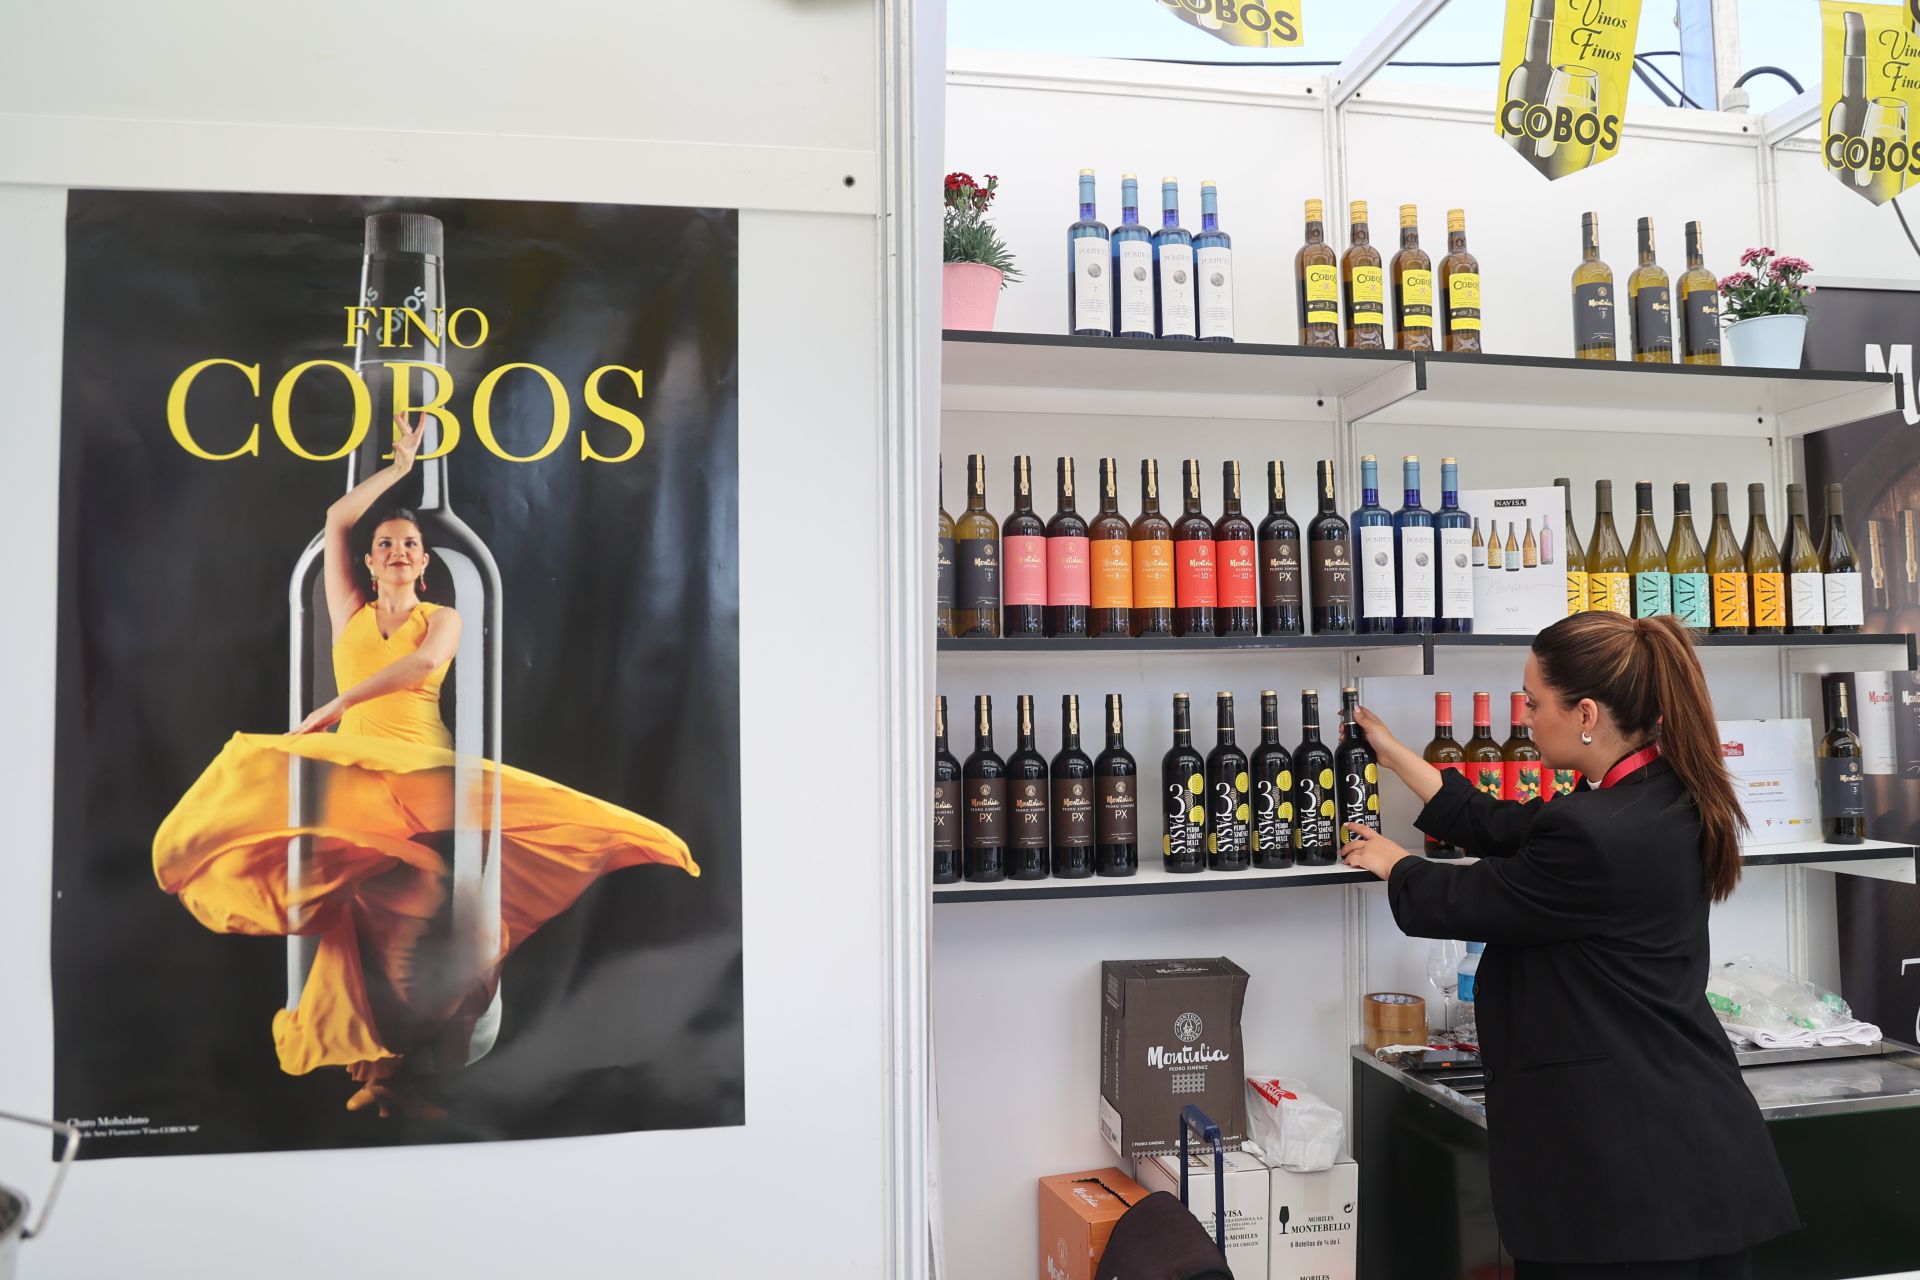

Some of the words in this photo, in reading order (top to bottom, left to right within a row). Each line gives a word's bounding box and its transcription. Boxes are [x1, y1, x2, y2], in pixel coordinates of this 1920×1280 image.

[1569, 0, 1628, 29] Vinos
[1570, 27, 1622, 62] Finos
[1878, 29, 1920, 60] Vin
[1500, 99, 1619, 151] COBOS
[342, 306, 489, 349] FINO
[166, 356, 646, 464] COBOS
[1495, 499, 1526, 507] NAVISA
[1200, 572, 1209, 580] 10
[1241, 572, 1249, 580] 10
[1279, 572, 1292, 582] PX
[1333, 572, 1346, 582] PX
[1588, 576, 1608, 609] AÍZ
[1674, 576, 1696, 623] NAÍZ
[1715, 575, 1738, 622] NAÍZ
[1756, 576, 1777, 622] NAÍZ
[1793, 576, 1814, 620] NAÍZ
[1826, 576, 1848, 620] NAÍZ
[1169, 783, 1186, 818] 3
[1215, 782, 1233, 816] 3
[1257, 780, 1275, 814] 3
[1300, 778, 1317, 812] 3
[1345, 773, 1363, 806] 3
[979, 812, 993, 823] PX
[1024, 813, 1038, 824] PX
[1071, 812, 1085, 822] PX
[1115, 809, 1128, 820] PX
[1257, 809, 1276, 850] PASAS
[1300, 808, 1318, 848] PASAS
[1169, 813, 1186, 854] PASAS
[1215, 811, 1234, 852] PASAS
[1147, 1042, 1230, 1070] Montulia
[97, 1114, 150, 1127] Mohedano
[1211, 1210, 1243, 1219] NVISA
[1291, 1222, 1351, 1234] MONTEBELLO
[1308, 1215, 1335, 1223] MORILES
[1294, 1240, 1316, 1248] Botellas
[1330, 1238, 1336, 1246] de
